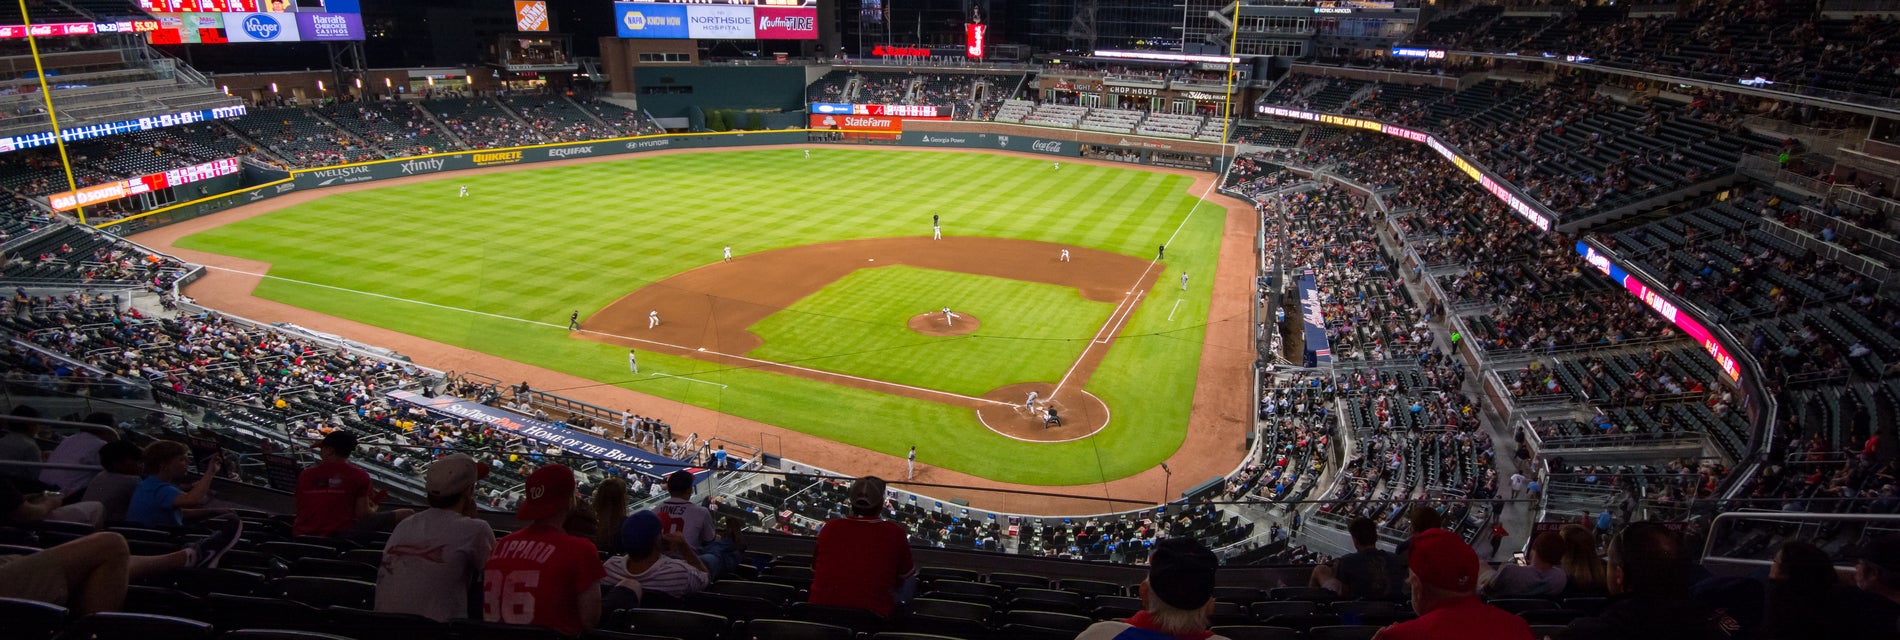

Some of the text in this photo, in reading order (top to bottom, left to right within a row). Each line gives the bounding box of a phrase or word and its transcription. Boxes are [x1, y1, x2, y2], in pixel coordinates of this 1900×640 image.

[518, 1, 545, 31] HOME
[97, 23, 117, 32] 10:23
[246, 18, 278, 38] Kroger
[785, 16, 813, 30] TIRE
[1132, 88, 1158, 96] HOUSE
[1276, 108, 1288, 116] BELTS
[1300, 112, 1314, 120] LIVES
[1344, 118, 1356, 126] LAW
[1388, 126, 1399, 135] CLICK
[638, 139, 668, 147] HYUNDAI
[1032, 140, 1062, 152] Coca-Cola
[472, 151, 524, 163] QUIKRETE
[549, 146, 592, 157] EQUIFAX
[314, 166, 369, 178] WELLSTAR
[401, 158, 444, 174] xfinity
[54, 196, 77, 209] GAS
[88, 186, 122, 200] SOUTH
[522, 426, 654, 470] HOME OF THE BRAVES
[530, 484, 544, 499] W
[489, 540, 556, 564] LIPPARD
[483, 568, 540, 625] 36
